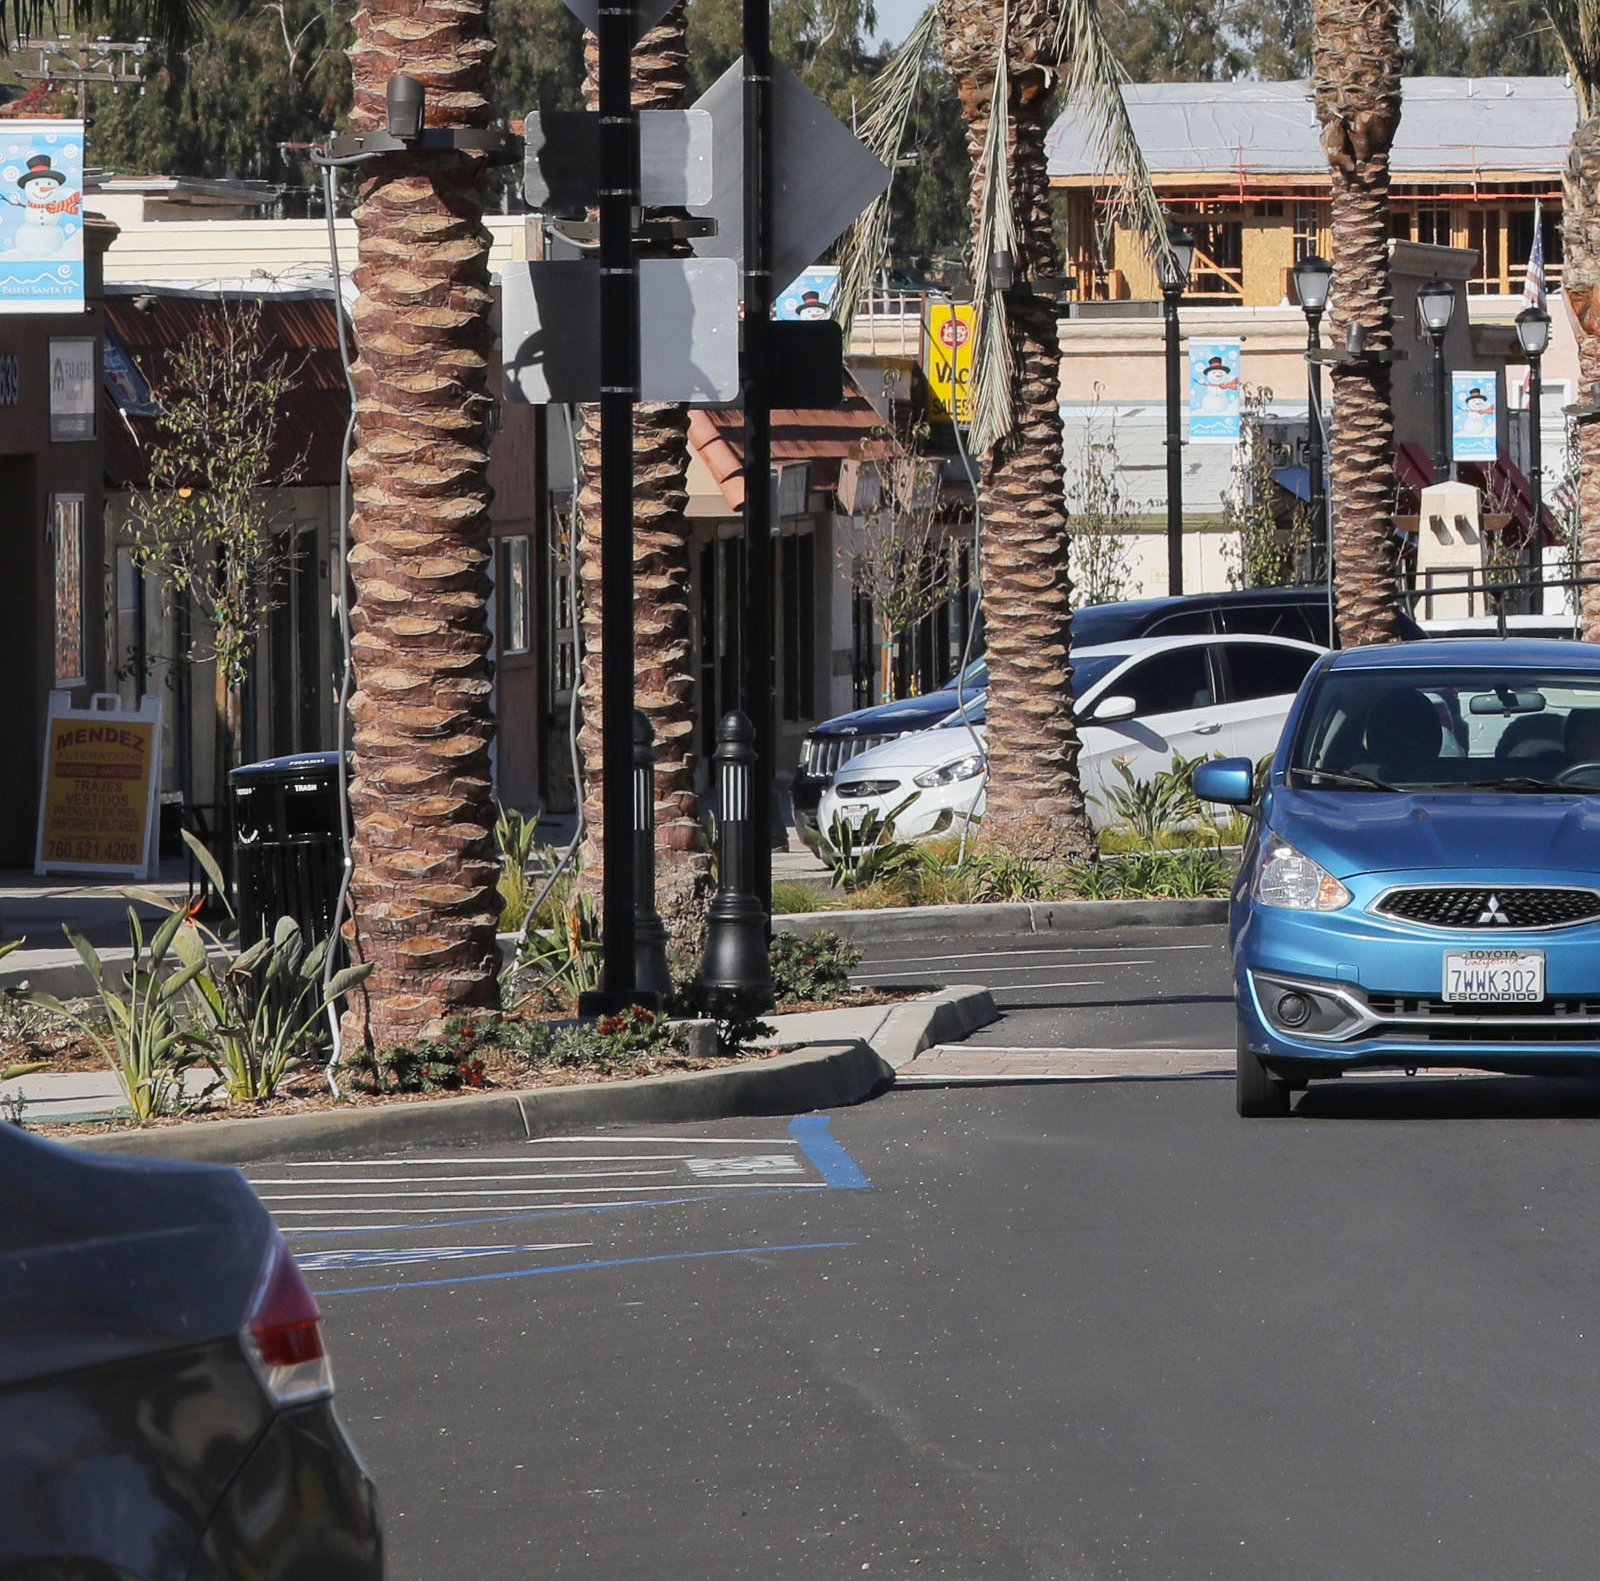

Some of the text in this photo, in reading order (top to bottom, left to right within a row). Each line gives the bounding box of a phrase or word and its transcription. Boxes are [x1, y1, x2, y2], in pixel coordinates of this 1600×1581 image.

[2, 285, 73, 295] PASEO SANTA FE
[56, 726, 145, 754] MENDEZ
[73, 779, 123, 793] TRAJES
[294, 784, 317, 792] TRASH
[66, 793, 129, 807] VESTIDOS
[1468, 950, 1519, 958] TOYOTA
[1451, 970, 1536, 993] 7WWK302
[1448, 992, 1538, 1001] ESCONDIDO
